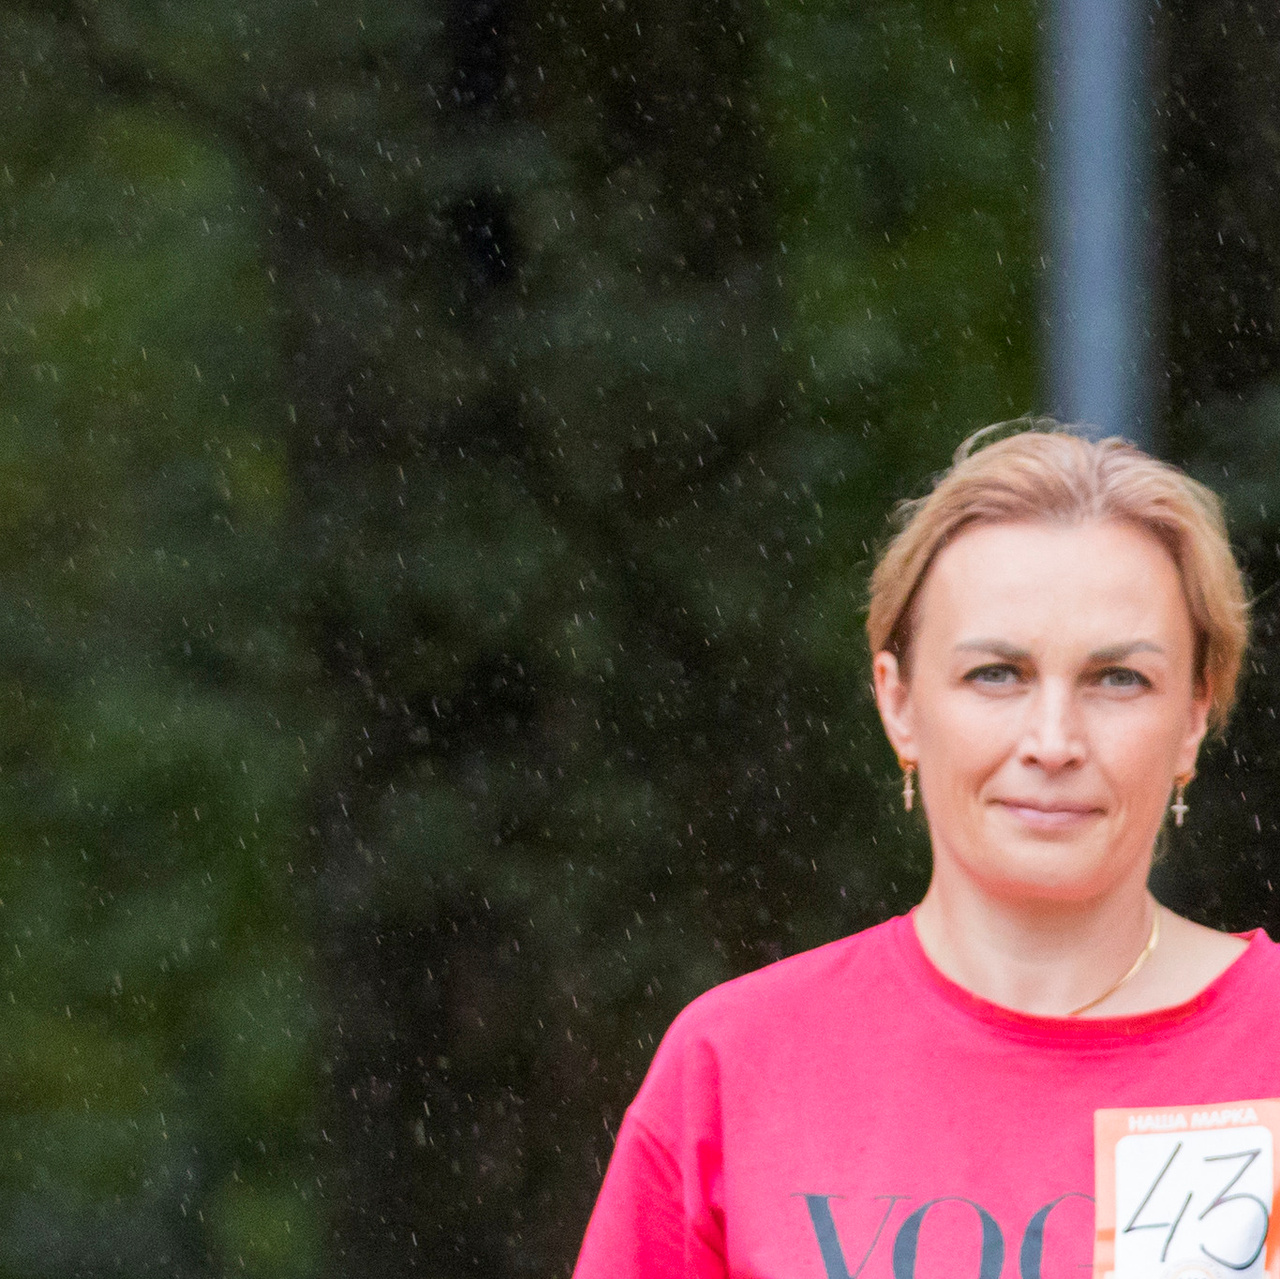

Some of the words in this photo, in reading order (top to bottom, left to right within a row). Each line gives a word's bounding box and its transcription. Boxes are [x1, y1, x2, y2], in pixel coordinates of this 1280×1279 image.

[1128, 1113, 1188, 1131] НАША
[1190, 1107, 1259, 1128] МАРКА
[1123, 1140, 1269, 1271] 43
